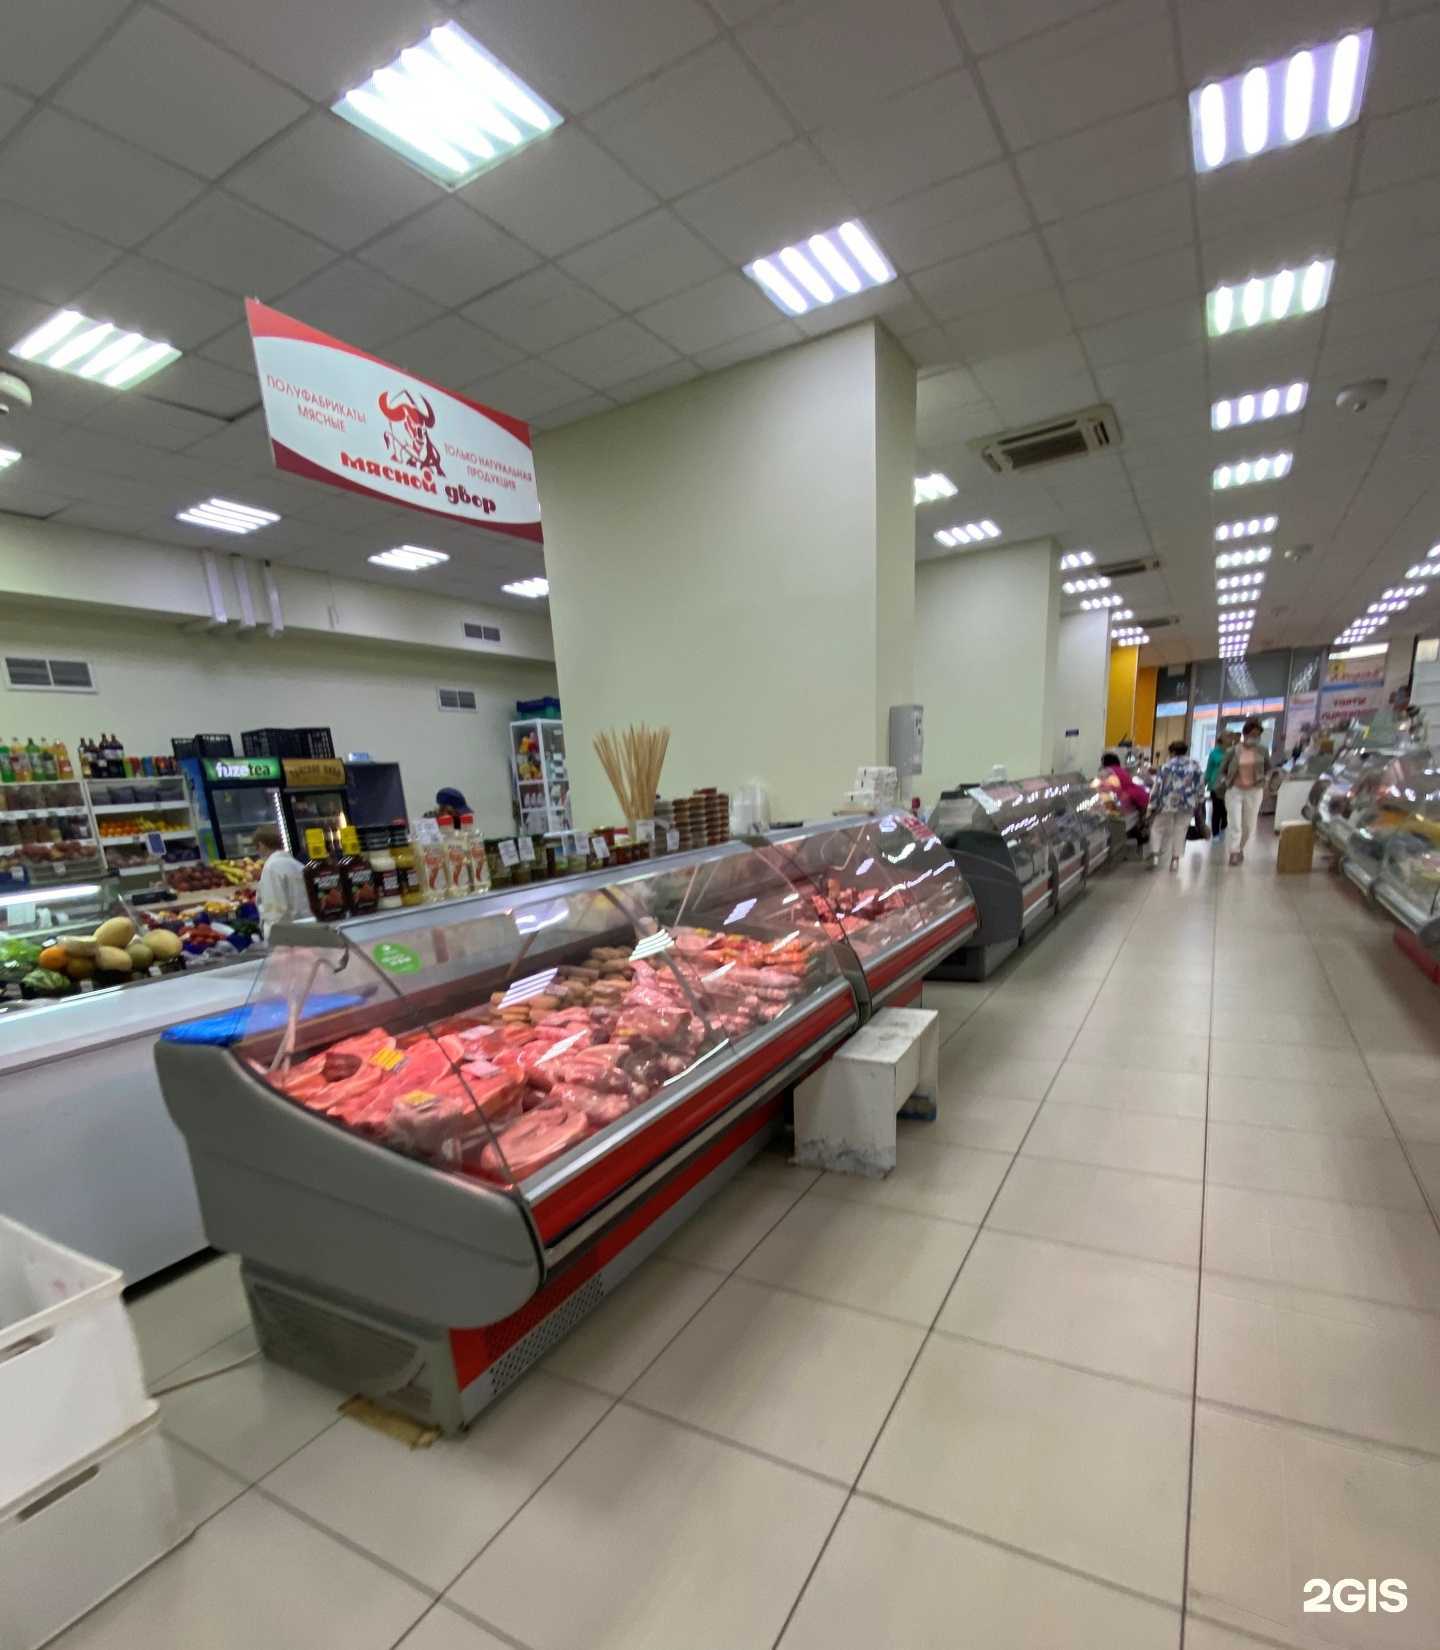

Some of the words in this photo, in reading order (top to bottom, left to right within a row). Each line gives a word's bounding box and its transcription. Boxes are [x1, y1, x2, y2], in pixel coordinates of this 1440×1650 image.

[266, 374, 367, 424] ПОЛУФАБРИКАТЫ
[297, 404, 346, 433] МЯСНЫЕ
[444, 442, 478, 465] ТОЛЬКО
[478, 456, 532, 482] НАТУРАЛЬНАЯ
[466, 464, 517, 491] ПРОДУКЦИЯ
